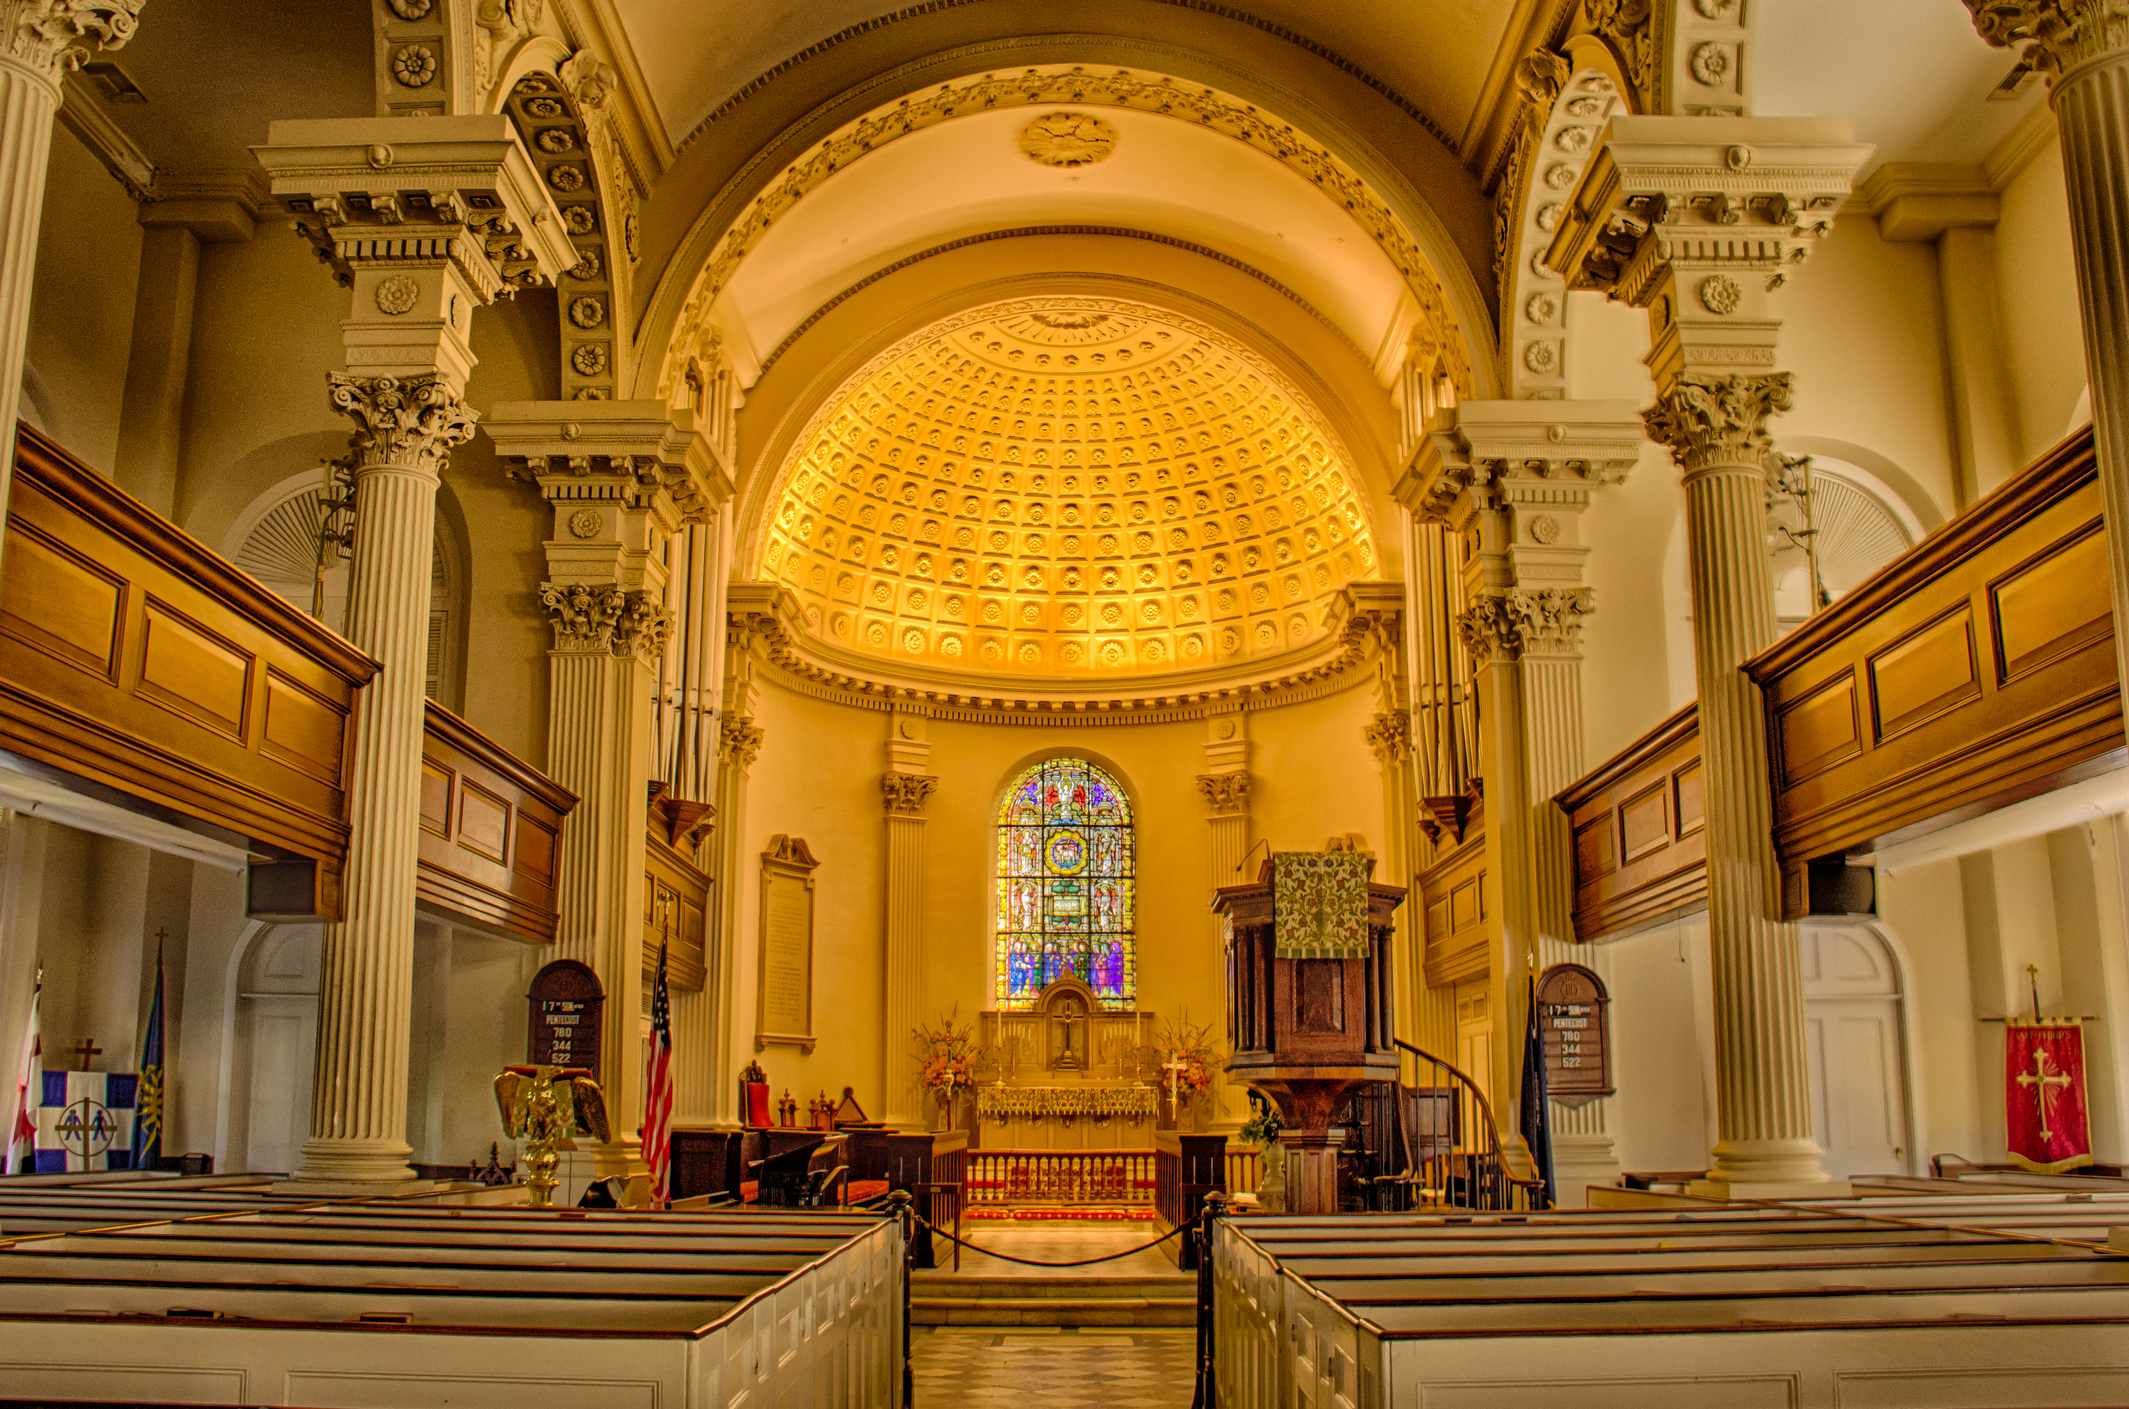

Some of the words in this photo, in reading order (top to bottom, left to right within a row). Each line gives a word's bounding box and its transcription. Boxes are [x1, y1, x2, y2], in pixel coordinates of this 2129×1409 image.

[546, 1014, 581, 1025] PENTECOST
[1553, 1017, 1588, 1028] PENTECOST
[553, 1027, 573, 1038] 780
[1562, 1030, 1581, 1042] 780
[552, 1040, 572, 1051] 344
[1562, 1043, 1581, 1055] 344
[551, 1053, 571, 1064] 522
[1562, 1057, 1581, 1068] 522
